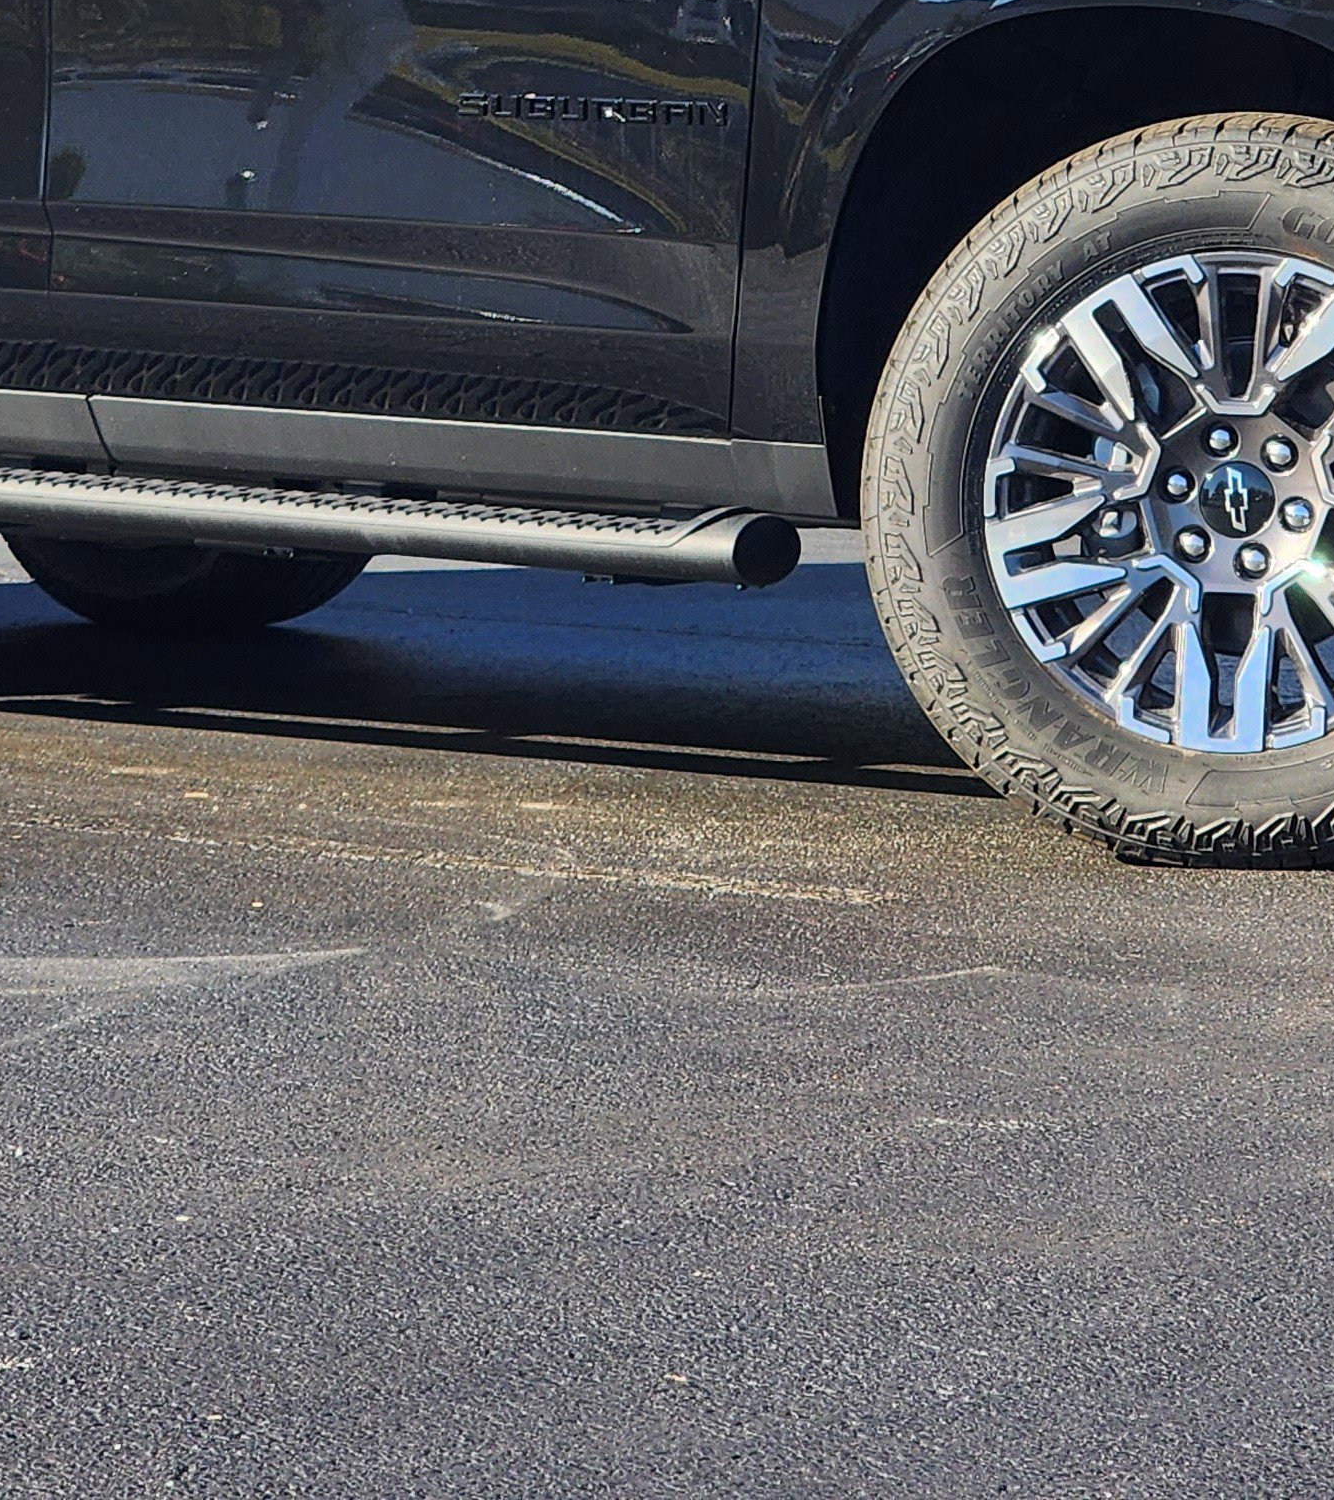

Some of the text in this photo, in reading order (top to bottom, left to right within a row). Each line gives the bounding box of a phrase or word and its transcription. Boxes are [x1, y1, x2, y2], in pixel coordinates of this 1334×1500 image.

[458, 92, 729, 127] SUBURBAN
[955, 259, 1066, 400] TERRITORY
[1083, 231, 1112, 263] AT
[942, 575, 1168, 794] WRANGLER
